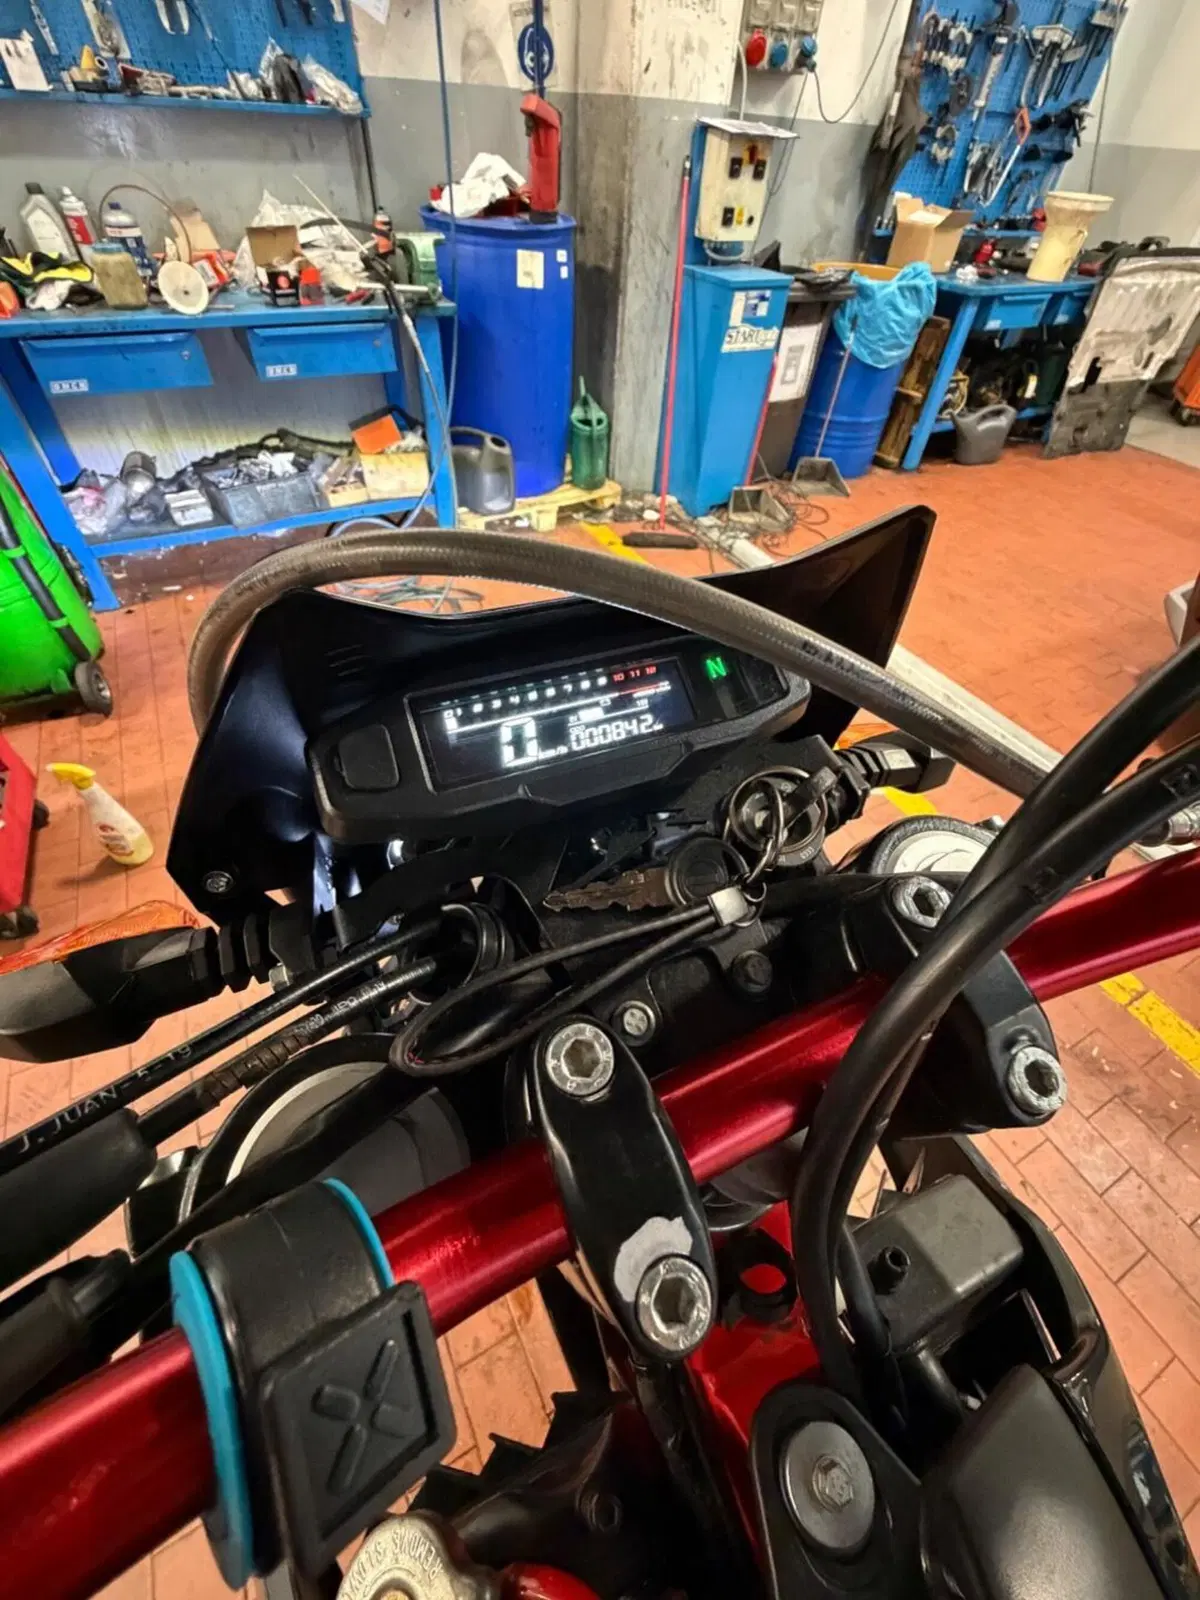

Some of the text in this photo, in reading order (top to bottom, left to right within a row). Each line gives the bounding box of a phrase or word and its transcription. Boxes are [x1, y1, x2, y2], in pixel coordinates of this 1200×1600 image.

[705, 656, 727, 680] N
[500, 716, 539, 768] 0
[569, 713, 655, 752] 000842
